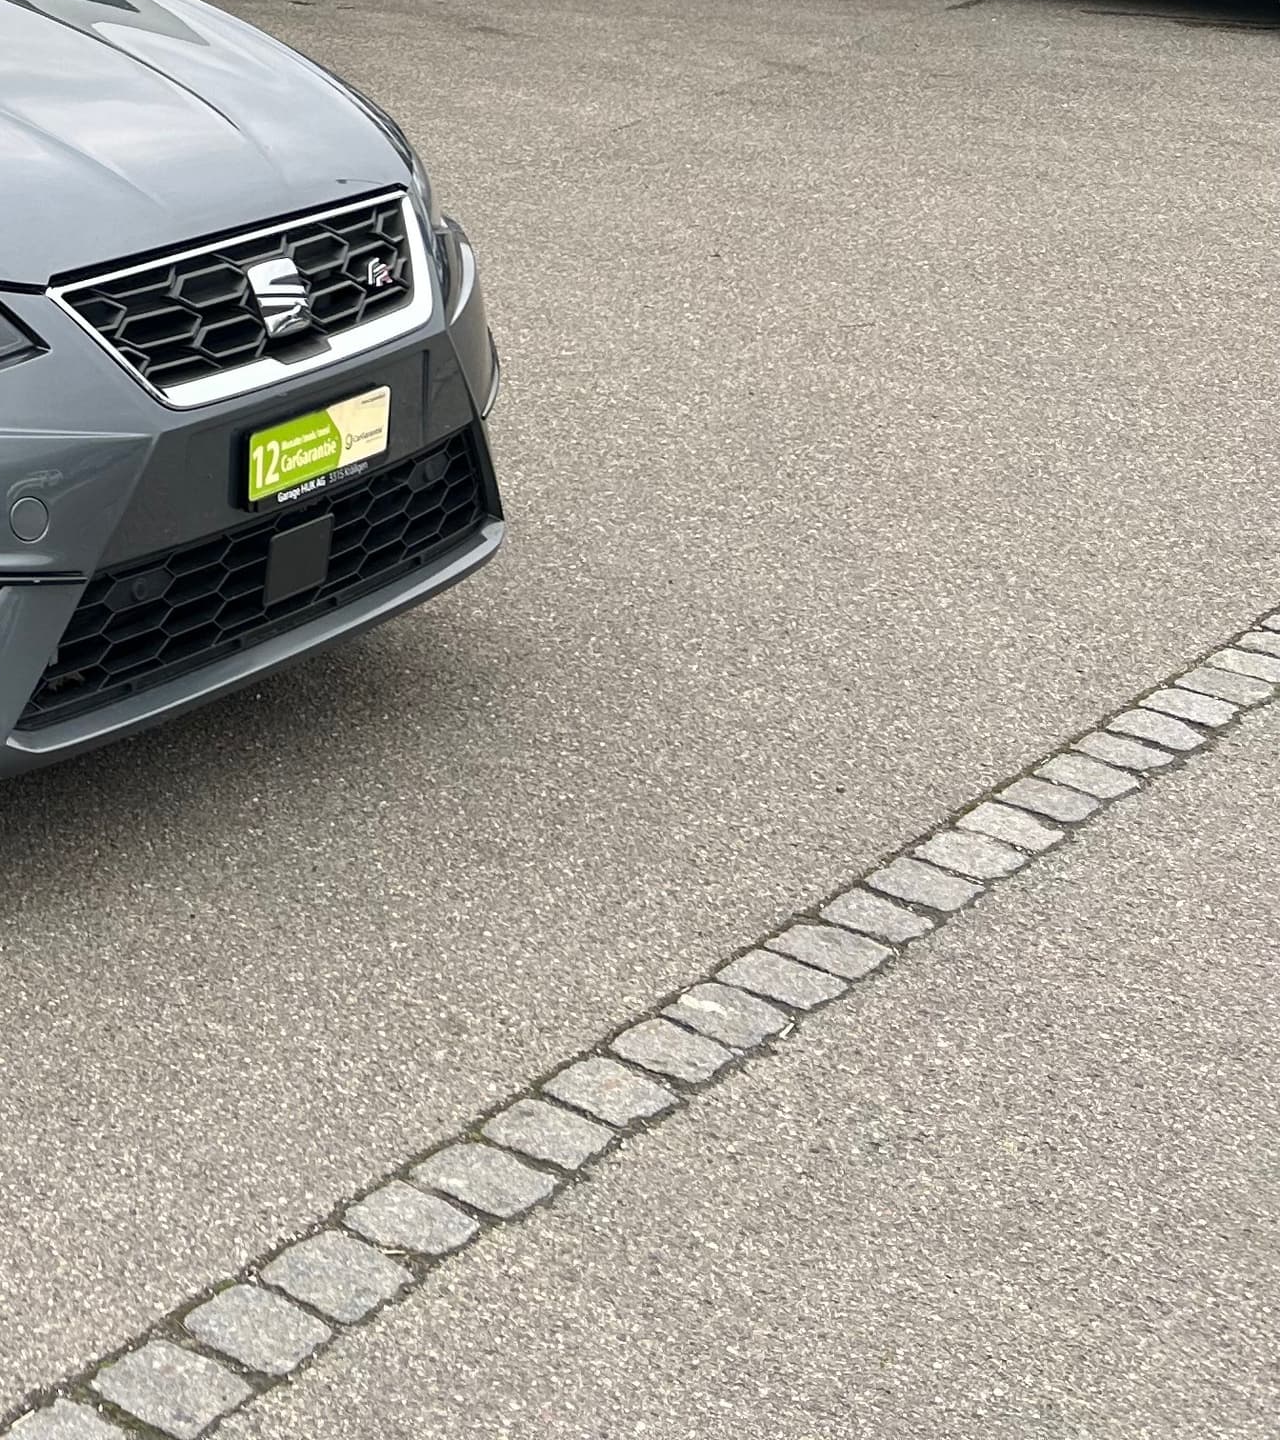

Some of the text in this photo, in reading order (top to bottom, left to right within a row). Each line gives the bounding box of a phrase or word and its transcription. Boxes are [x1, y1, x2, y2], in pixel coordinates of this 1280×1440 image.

[252, 440, 280, 489] 12
[280, 437, 338, 473] CarGarantie
[277, 487, 301, 503] Garage
[300, 478, 316, 494] HUK
[316, 475, 327, 487] AG
